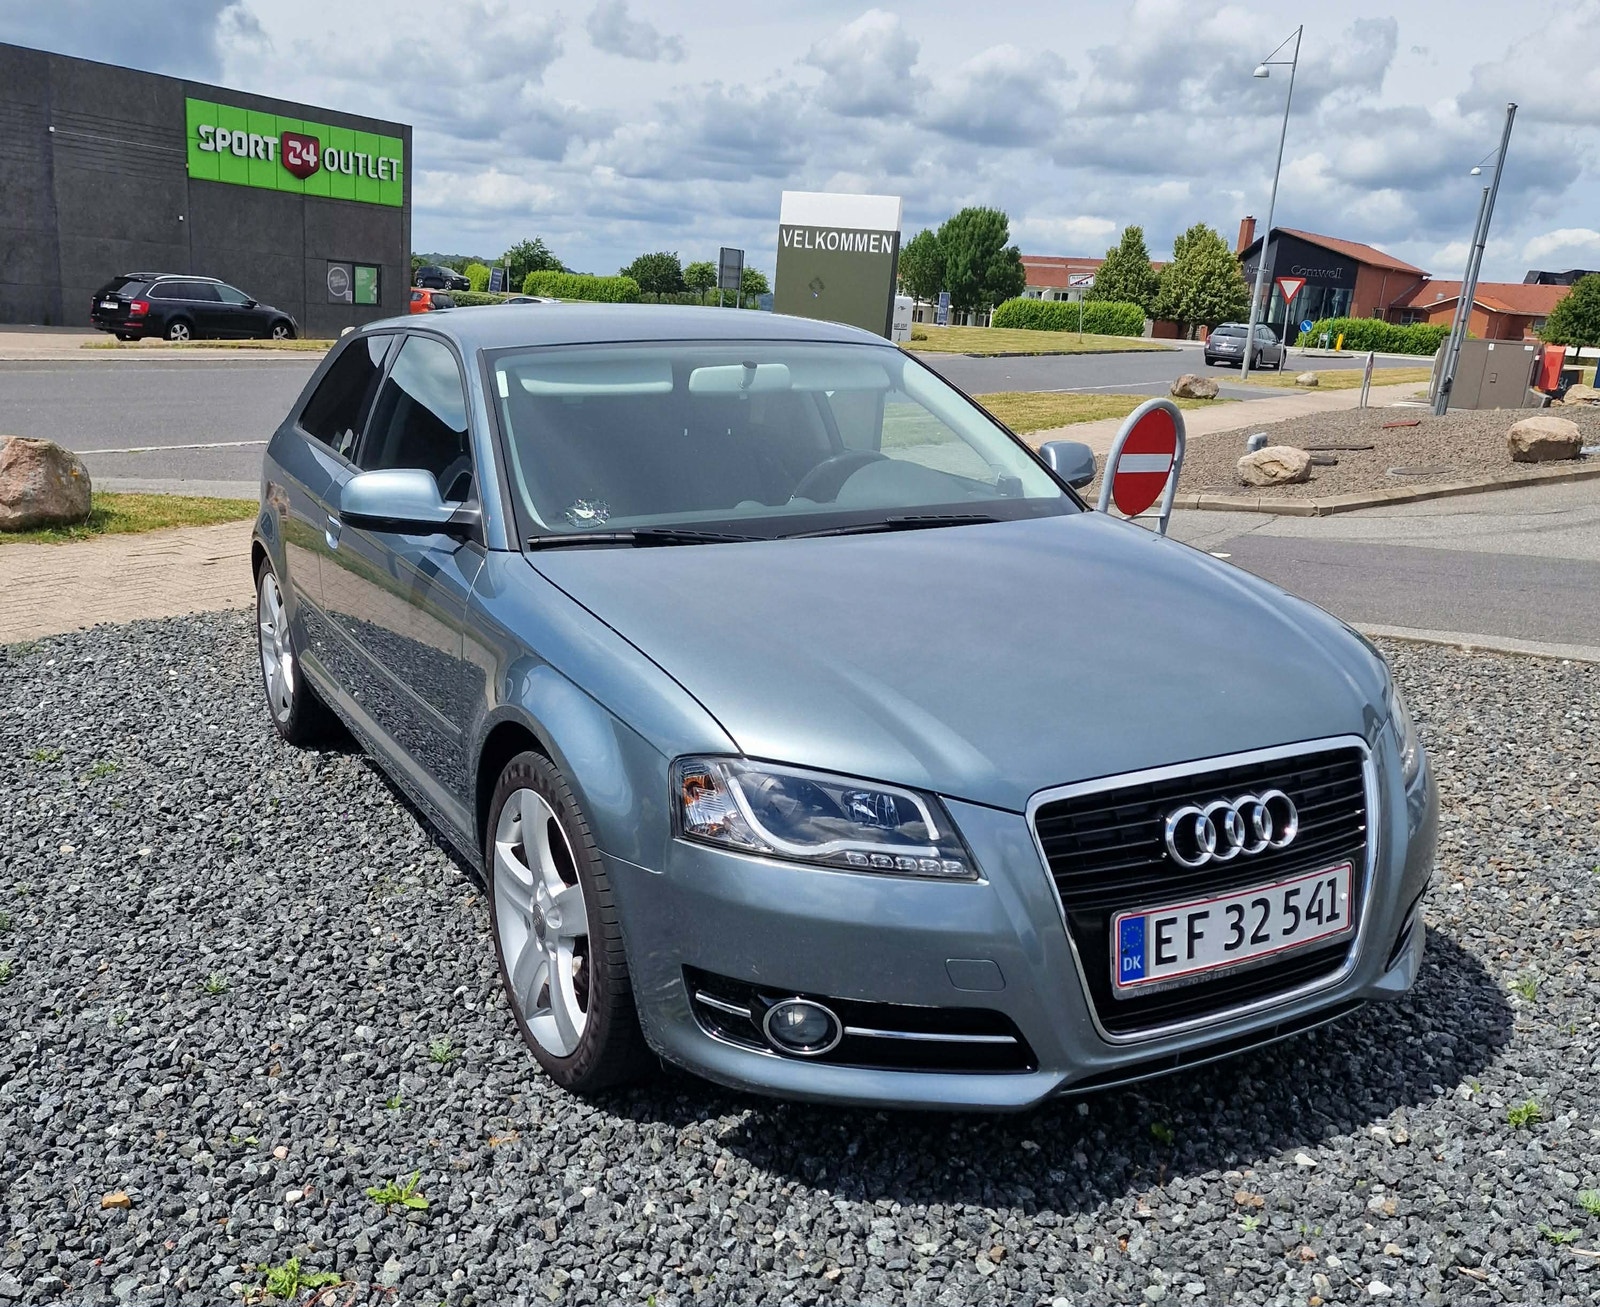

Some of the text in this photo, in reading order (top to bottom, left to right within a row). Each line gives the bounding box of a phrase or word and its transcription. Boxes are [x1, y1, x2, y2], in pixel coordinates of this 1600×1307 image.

[199, 124, 400, 182] SPORT 24 OUTLET
[782, 228, 893, 254] VELKOMMEN
[1290, 264, 1343, 279] Comwell
[1154, 876, 1340, 966] EF 32 541
[1123, 955, 1142, 972] DK
